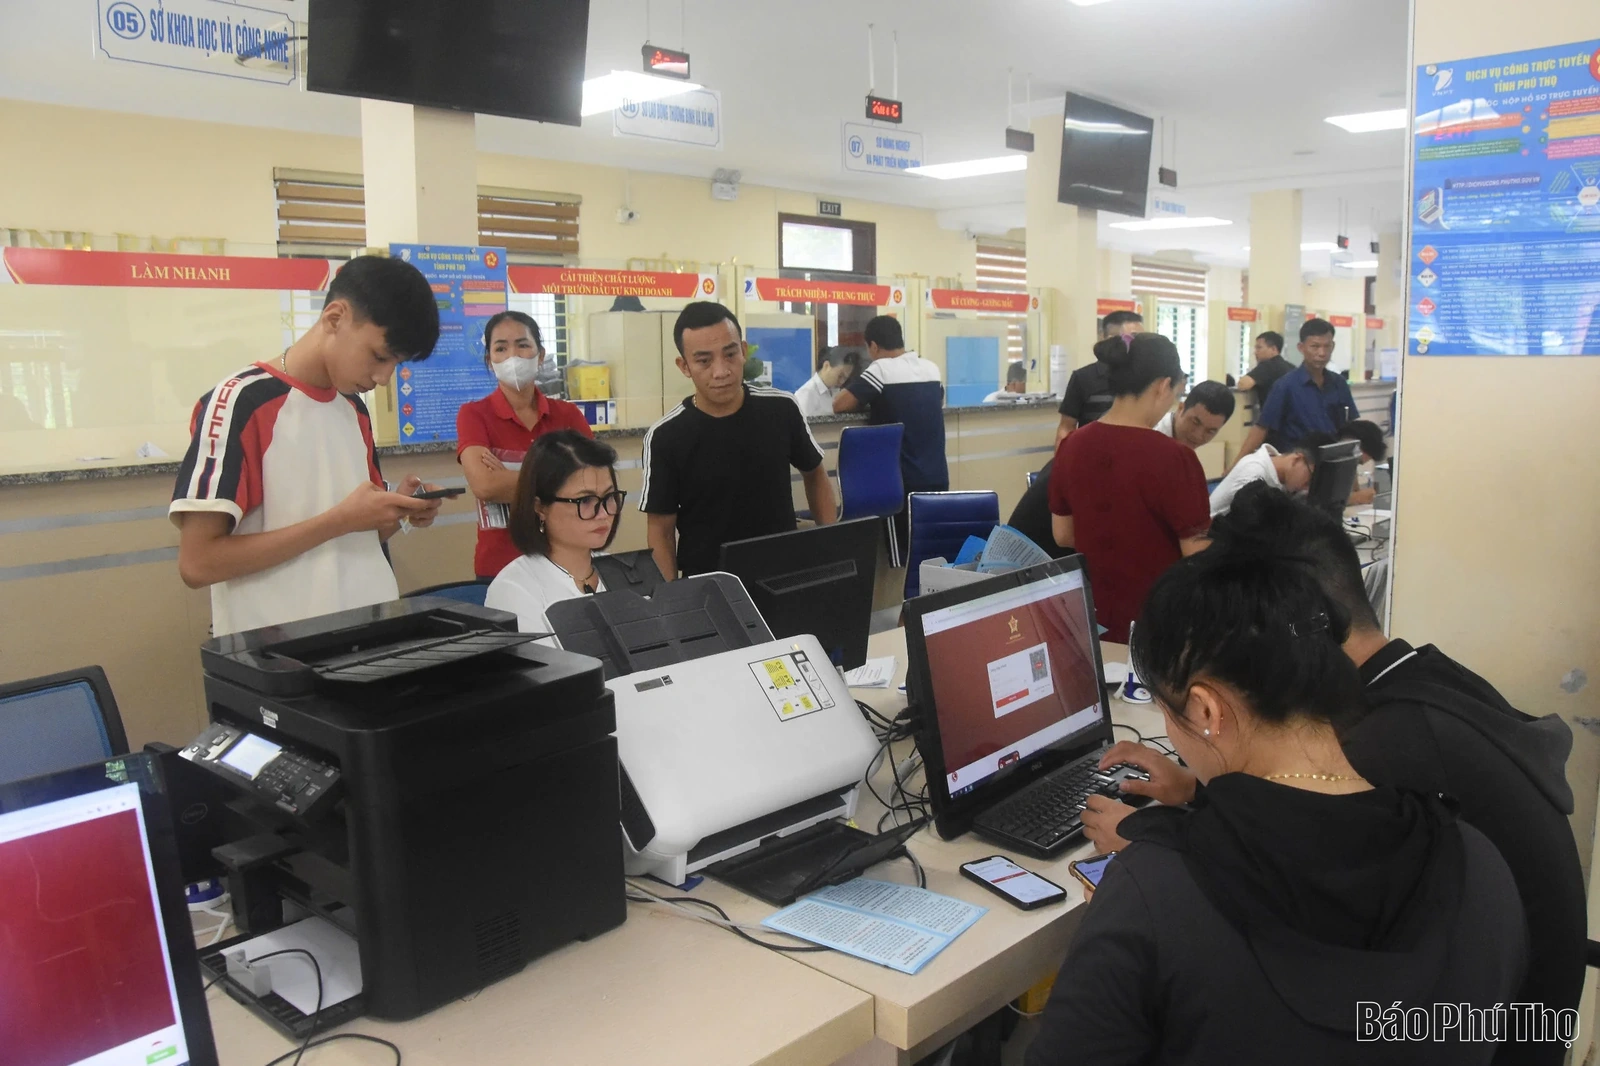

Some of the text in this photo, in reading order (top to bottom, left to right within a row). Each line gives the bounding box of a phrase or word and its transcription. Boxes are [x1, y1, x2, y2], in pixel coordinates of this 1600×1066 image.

[113, 10, 138, 34] 05
[150, 0, 289, 70] SỞ KHOA HỌC VÀ CÔNG NGHỆ
[1465, 53, 1591, 82] DỊCH VỤ CÔNG TRỰC TUYẾN
[1494, 75, 1558, 93] TỈNH PHÚ THỌ
[851, 140, 860, 153] 07
[822, 203, 839, 214] EXIT
[131, 262, 231, 281] LÀM NHANH
[560, 270, 656, 286] CẢI THIỆN CHẤT LƯỢNG
[542, 282, 560, 293] MÔI
[592, 282, 610, 294] ĐẦU
[611, 285, 623, 295] TƯ
[623, 286, 644, 296] KINH
[645, 287, 673, 296] DOANH
[775, 285, 801, 298] TRÁCH
[803, 287, 828, 301] NHIỆM
[832, 291, 856, 300] TRUNG
[856, 291, 876, 303] THỰC
[208, 377, 241, 457] GUCCI
